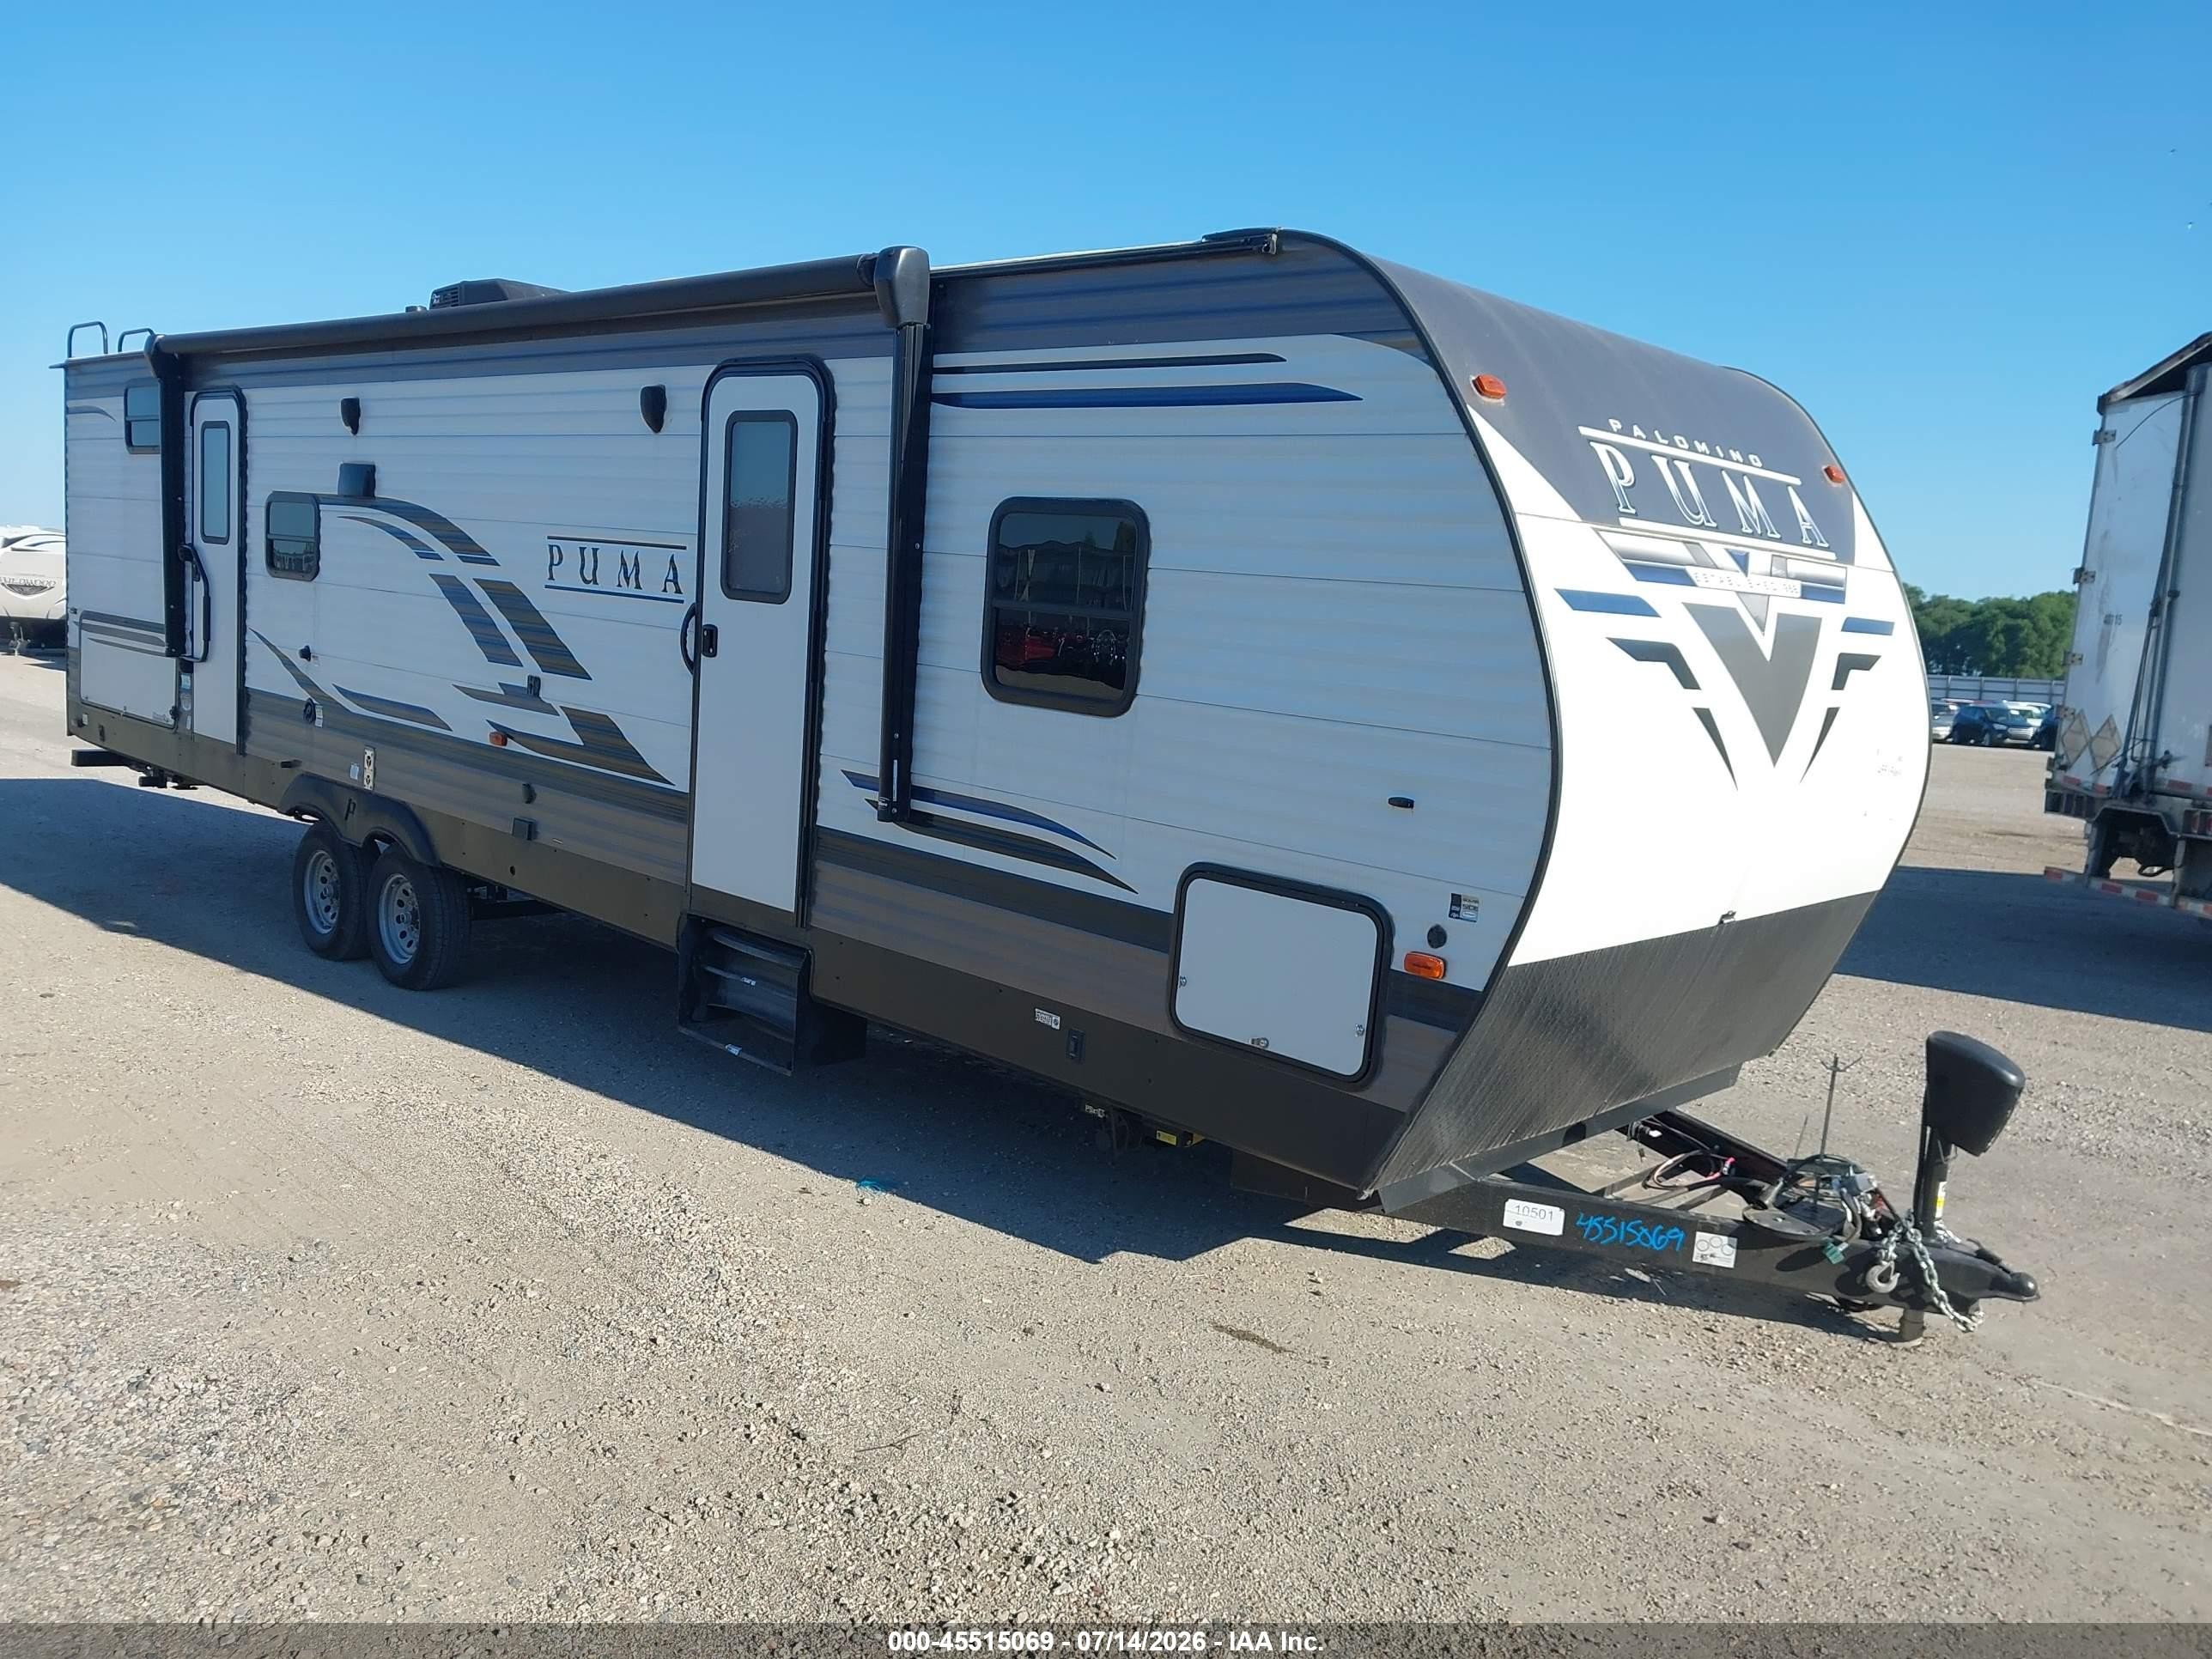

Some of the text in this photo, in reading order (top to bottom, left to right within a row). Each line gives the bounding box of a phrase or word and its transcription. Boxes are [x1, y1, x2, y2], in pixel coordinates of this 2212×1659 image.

[1607, 417, 1763, 468] PALOMINO
[1589, 441, 1830, 548] PUMA
[547, 544, 684, 595] PUMA
[1515, 1204, 1554, 1221] 10501
[1575, 1211, 1685, 1251] 45515069
